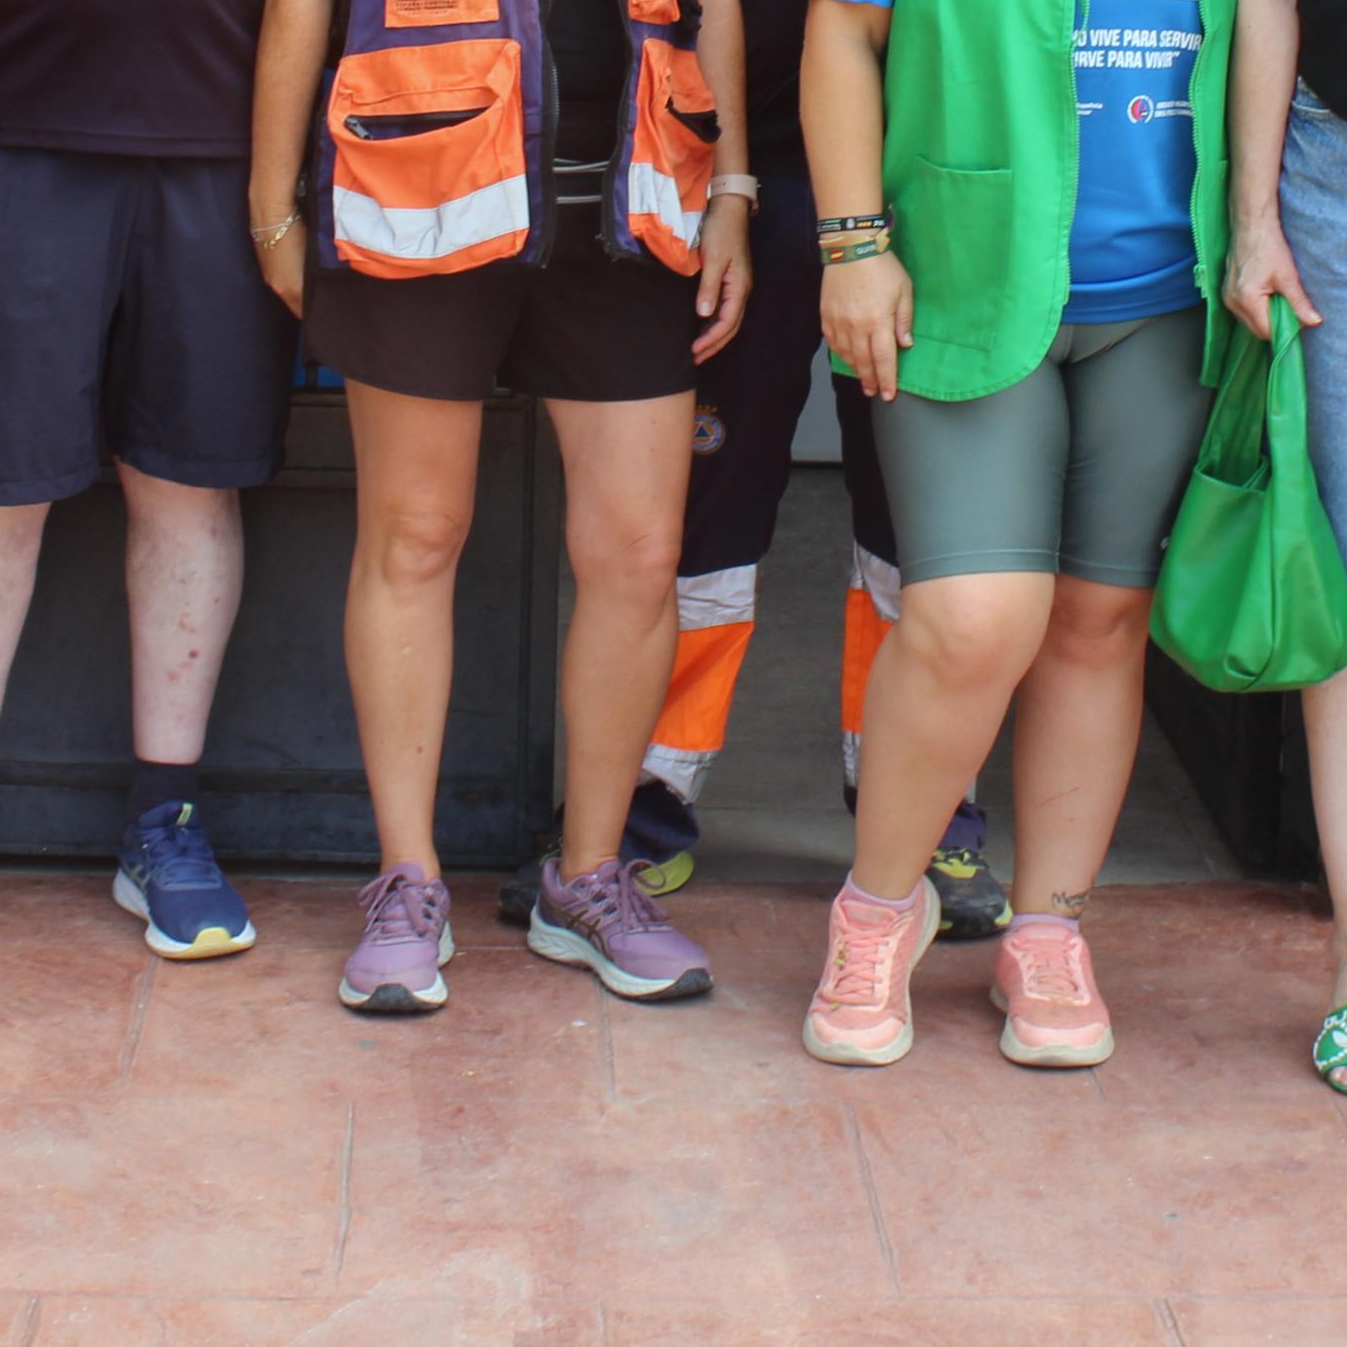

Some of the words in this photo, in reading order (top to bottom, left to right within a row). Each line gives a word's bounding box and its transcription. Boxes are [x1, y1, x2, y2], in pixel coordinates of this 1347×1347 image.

[1089, 29, 1121, 47] VIVE
[1123, 29, 1158, 48] PARA
[1107, 50, 1143, 69] PARA
